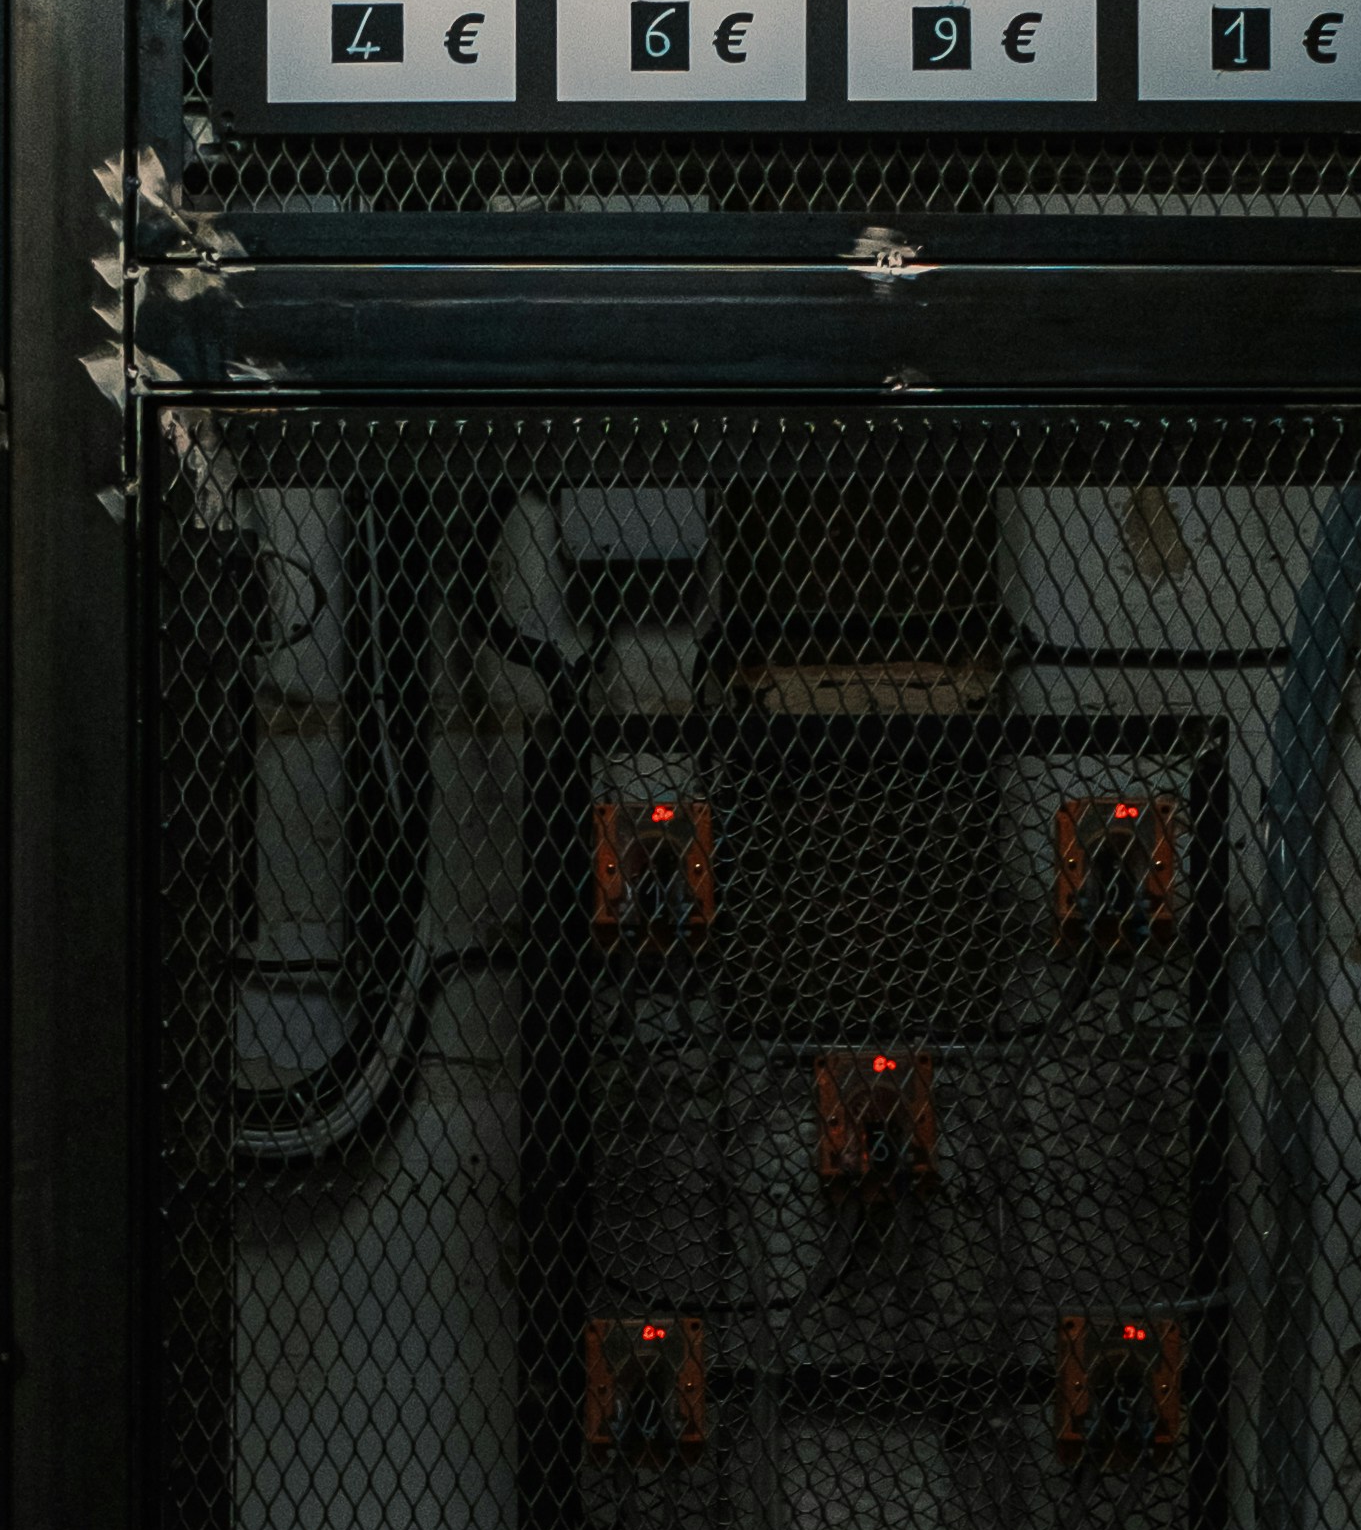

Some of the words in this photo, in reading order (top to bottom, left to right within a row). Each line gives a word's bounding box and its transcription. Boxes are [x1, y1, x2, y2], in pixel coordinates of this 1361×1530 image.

[346, 11, 382, 60] 4
[443, 11, 486, 64] €
[643, 6, 672, 58] 6
[712, 11, 754, 64] €
[932, 14, 959, 63] 9
[1002, 12, 1043, 64] €
[1224, 12, 1249, 64] 1
[1303, 12, 1344, 64] €
